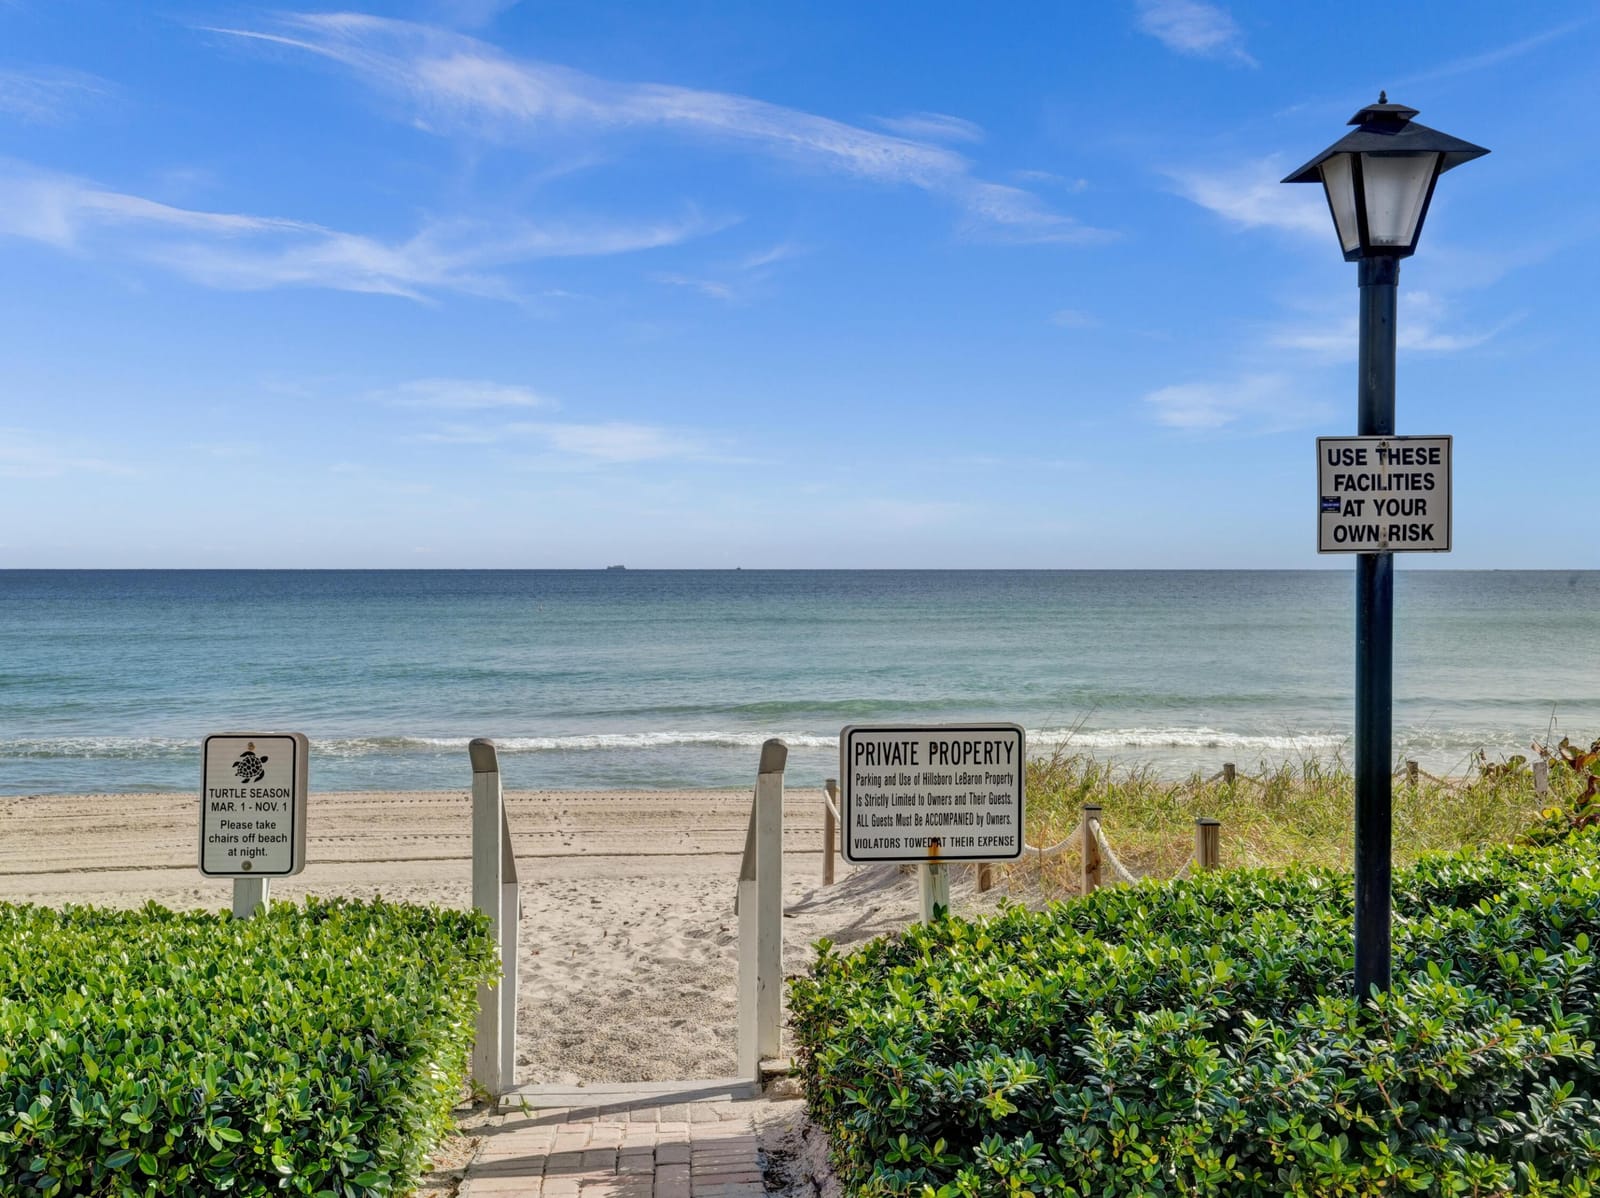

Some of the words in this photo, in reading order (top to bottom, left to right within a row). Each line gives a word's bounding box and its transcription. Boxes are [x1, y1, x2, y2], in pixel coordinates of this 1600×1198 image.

[1327, 448, 1367, 466] USE
[1375, 448, 1441, 465] THESE
[1334, 473, 1435, 491] FACILITIES
[1343, 499, 1365, 517] AT
[1373, 499, 1427, 516] YOUR
[1333, 525, 1379, 543] OWN
[1388, 524, 1434, 542] RISK
[855, 742, 919, 766] PRIVATE
[929, 740, 1014, 765] PROPERTY
[856, 773, 882, 788] Parking
[885, 773, 896, 786] and
[899, 773, 911, 786] Use
[913, 773, 921, 785] of
[923, 772, 952, 785] Hillsboro
[955, 772, 982, 785] LeBaron
[985, 772, 1013, 786] Property
[209, 788, 247, 798] TURTLE
[249, 788, 290, 798] SEASON
[856, 793, 862, 807] Is
[864, 793, 889, 808] Strictly
[892, 793, 915, 806] Limited
[918, 793, 925, 806] to
[927, 793, 952, 806] Owners
[954, 793, 966, 805] and
[969, 792, 986, 805] Their
[988, 792, 1013, 805] Guests.
[211, 802, 237, 812] MAR.
[241, 802, 245, 811] 1
[255, 802, 279, 811] NOV.
[282, 802, 287, 811] 1
[220, 820, 253, 829] Please
[256, 820, 276, 829] take
[856, 814, 869, 827] ALL
[871, 814, 893, 827] Guests
[896, 813, 912, 826] Must
[915, 813, 923, 826] Be
[925, 812, 974, 826] ACCOMPANIED
[977, 812, 984, 827] by
[986, 812, 1012, 825] Owners.
[209, 834, 239, 843] chairs
[242, 833, 255, 843] off
[258, 833, 287, 843] beach
[854, 838, 901, 849] VIOLATORS
[904, 837, 936, 848] TOWED
[936, 837, 947, 847] AT
[950, 836, 974, 847] THEIR
[978, 836, 1014, 847] EXPENSE
[228, 847, 237, 856] at
[240, 847, 268, 858] night.
